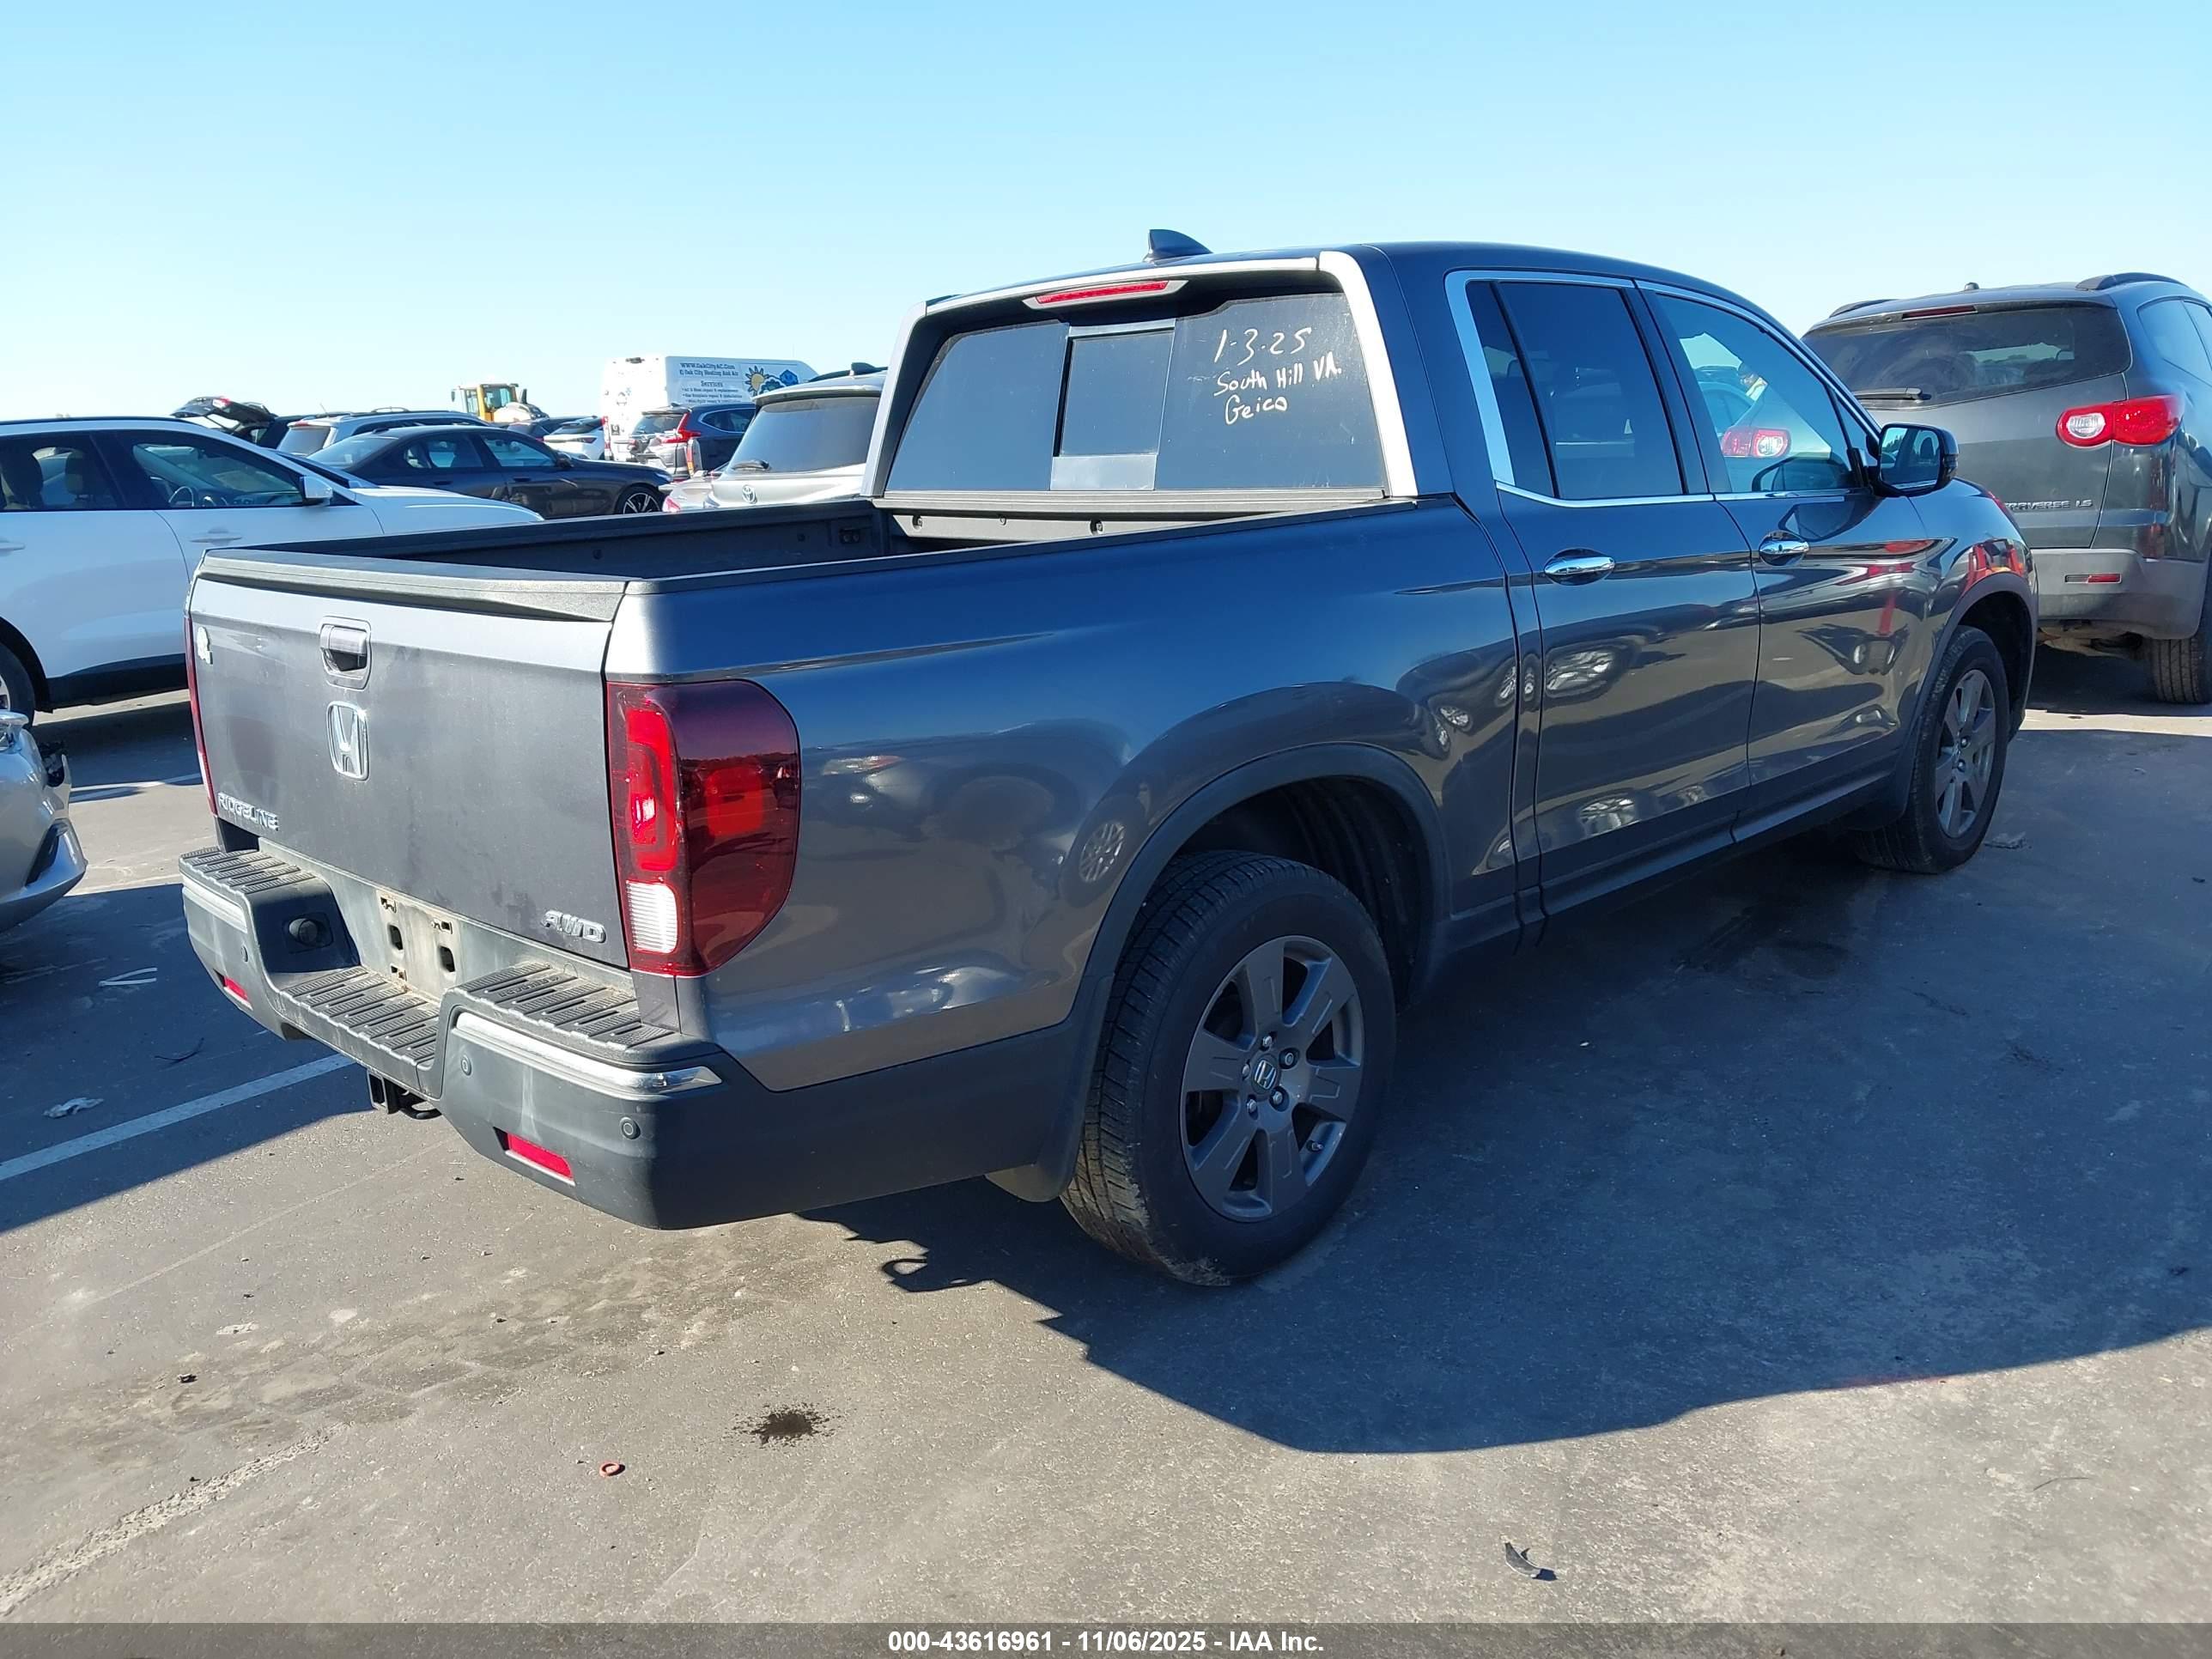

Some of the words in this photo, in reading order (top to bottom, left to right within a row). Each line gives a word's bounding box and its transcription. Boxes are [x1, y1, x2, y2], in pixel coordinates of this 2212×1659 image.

[1213, 368, 1267, 397] South
[1276, 362, 1304, 389] Hill
[1224, 394, 1288, 425] Geico
[217, 792, 279, 831] RIDGELINE
[540, 910, 606, 943] AWD
